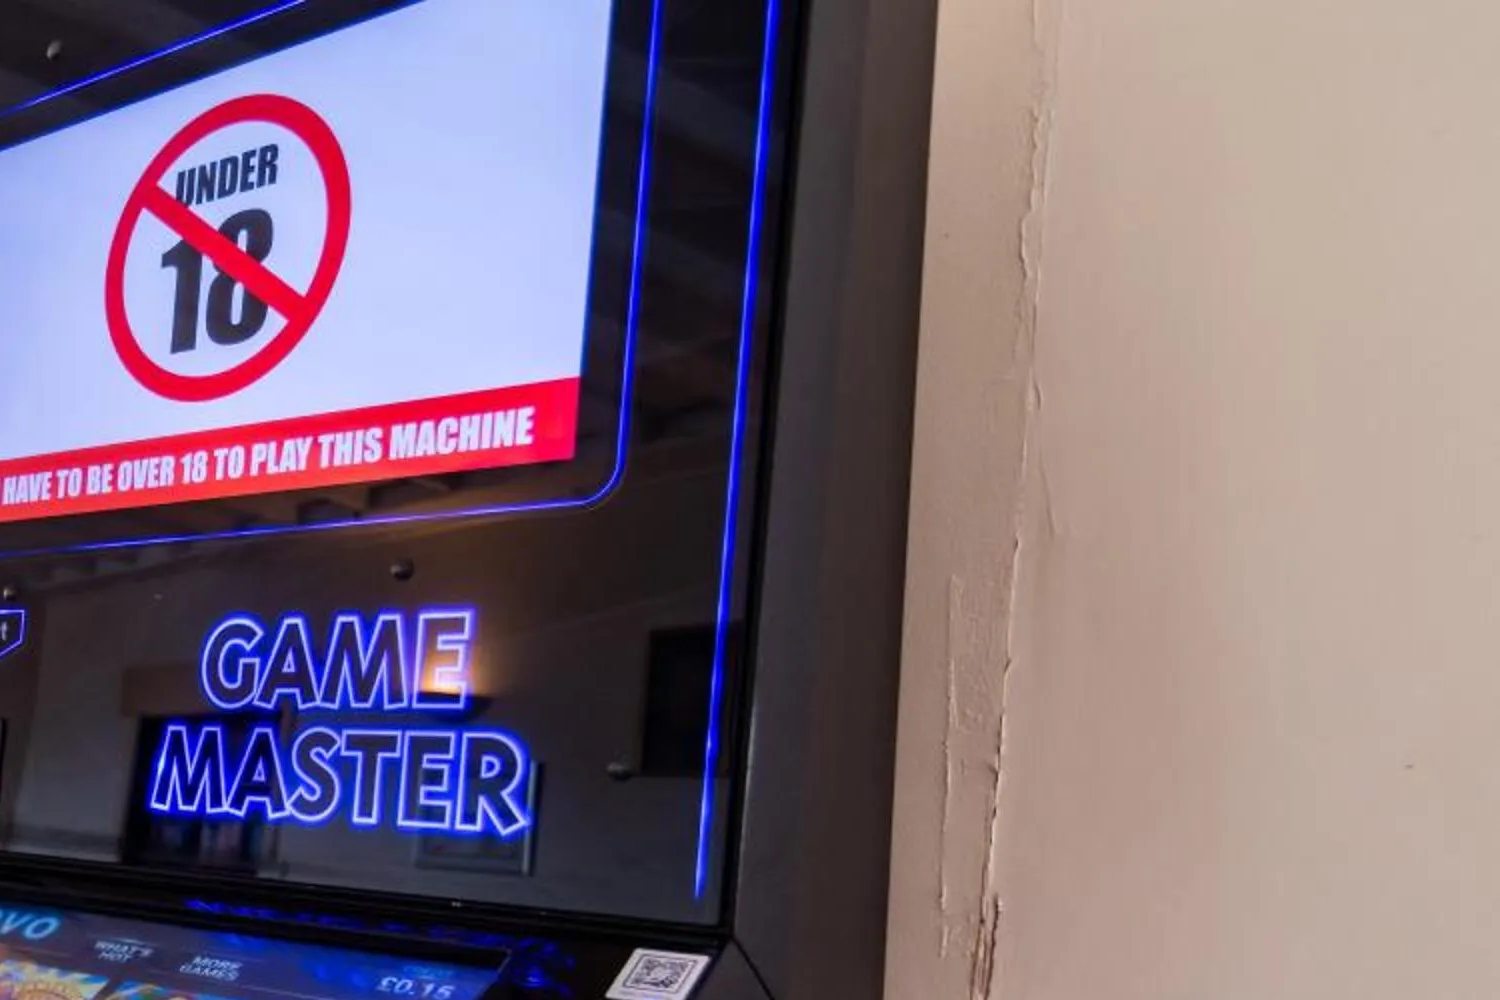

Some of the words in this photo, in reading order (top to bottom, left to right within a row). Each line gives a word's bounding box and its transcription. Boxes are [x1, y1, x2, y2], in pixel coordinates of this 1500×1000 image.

[175, 143, 279, 206] UNDER
[161, 207, 274, 354] 18
[2, 471, 52, 505] HAVE
[56, 468, 82, 499] TO
[86, 463, 113, 494] BE
[118, 455, 175, 491] OVER
[181, 451, 208, 485] 18
[214, 445, 246, 480] TO
[250, 436, 314, 477] PLAY
[318, 427, 383, 468] THIS
[389, 405, 535, 461] MACHINE
[201, 610, 472, 711] GAME
[151, 725, 529, 836] MASTER
[376, 975, 455, 1000] £0.15
